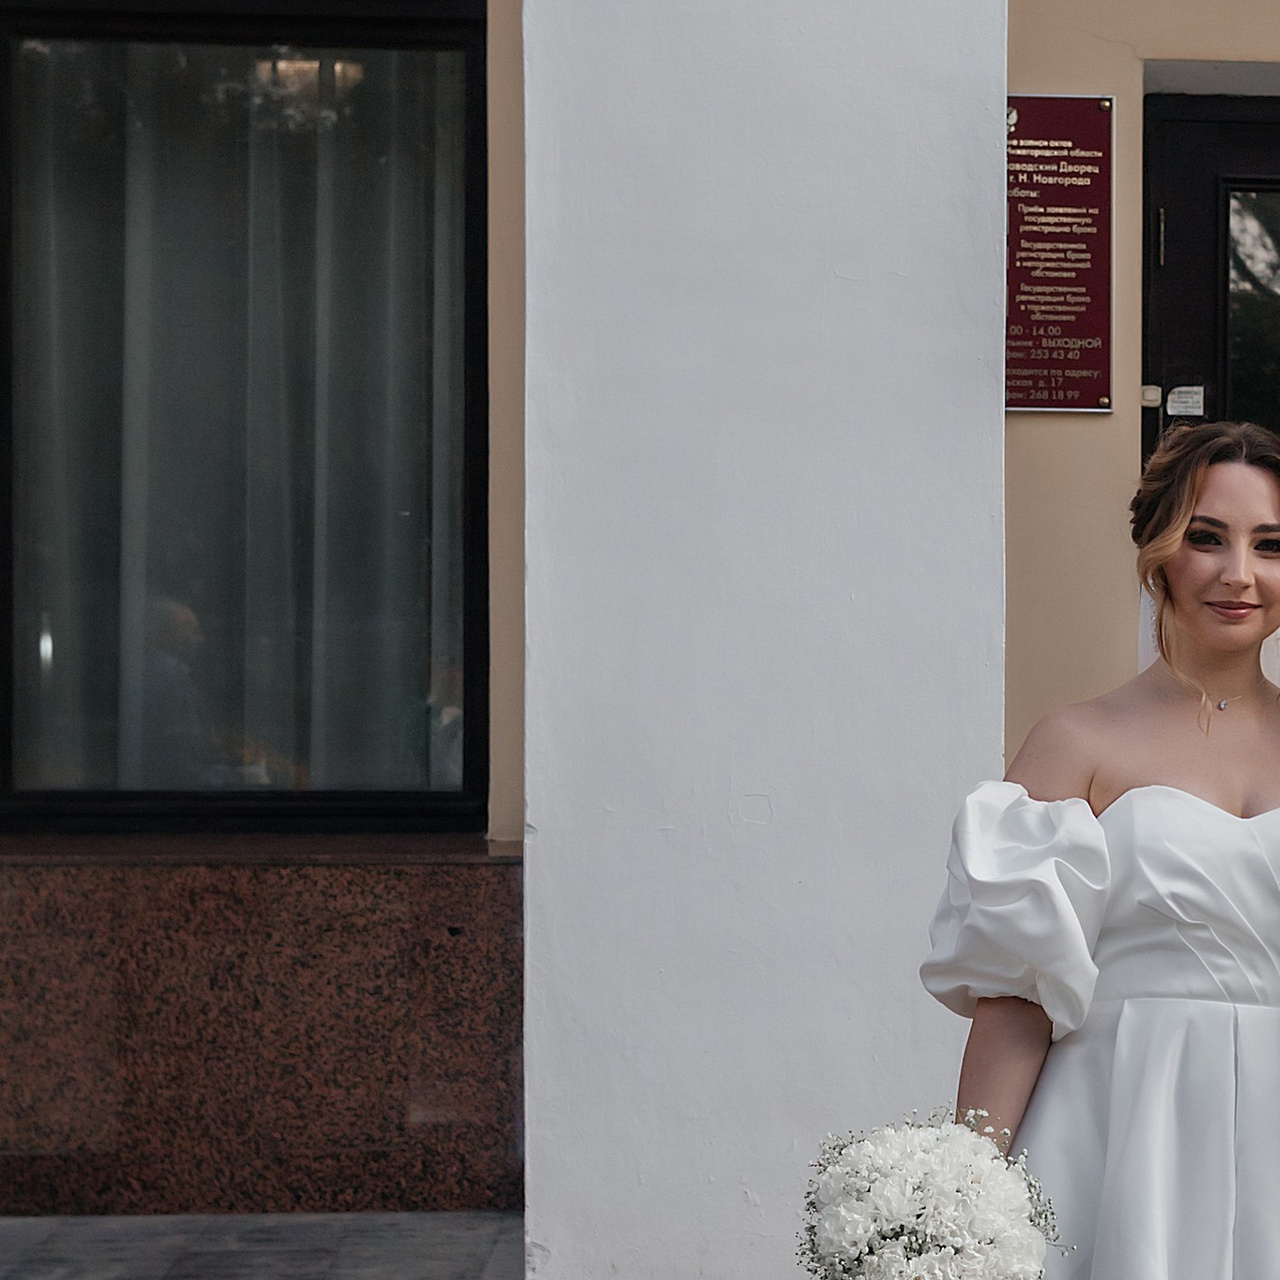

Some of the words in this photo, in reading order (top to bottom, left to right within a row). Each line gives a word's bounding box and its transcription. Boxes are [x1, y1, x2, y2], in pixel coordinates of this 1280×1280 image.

[1059, 161, 1099, 175] Дворец
[1033, 174, 1091, 187] Новгорода
[1007, 187, 1040, 197] аботы:
[1042, 337, 1102, 348] ВЫХОДНОЙ
[1052, 350, 1064, 359] 43
[1067, 350, 1080, 359] 40
